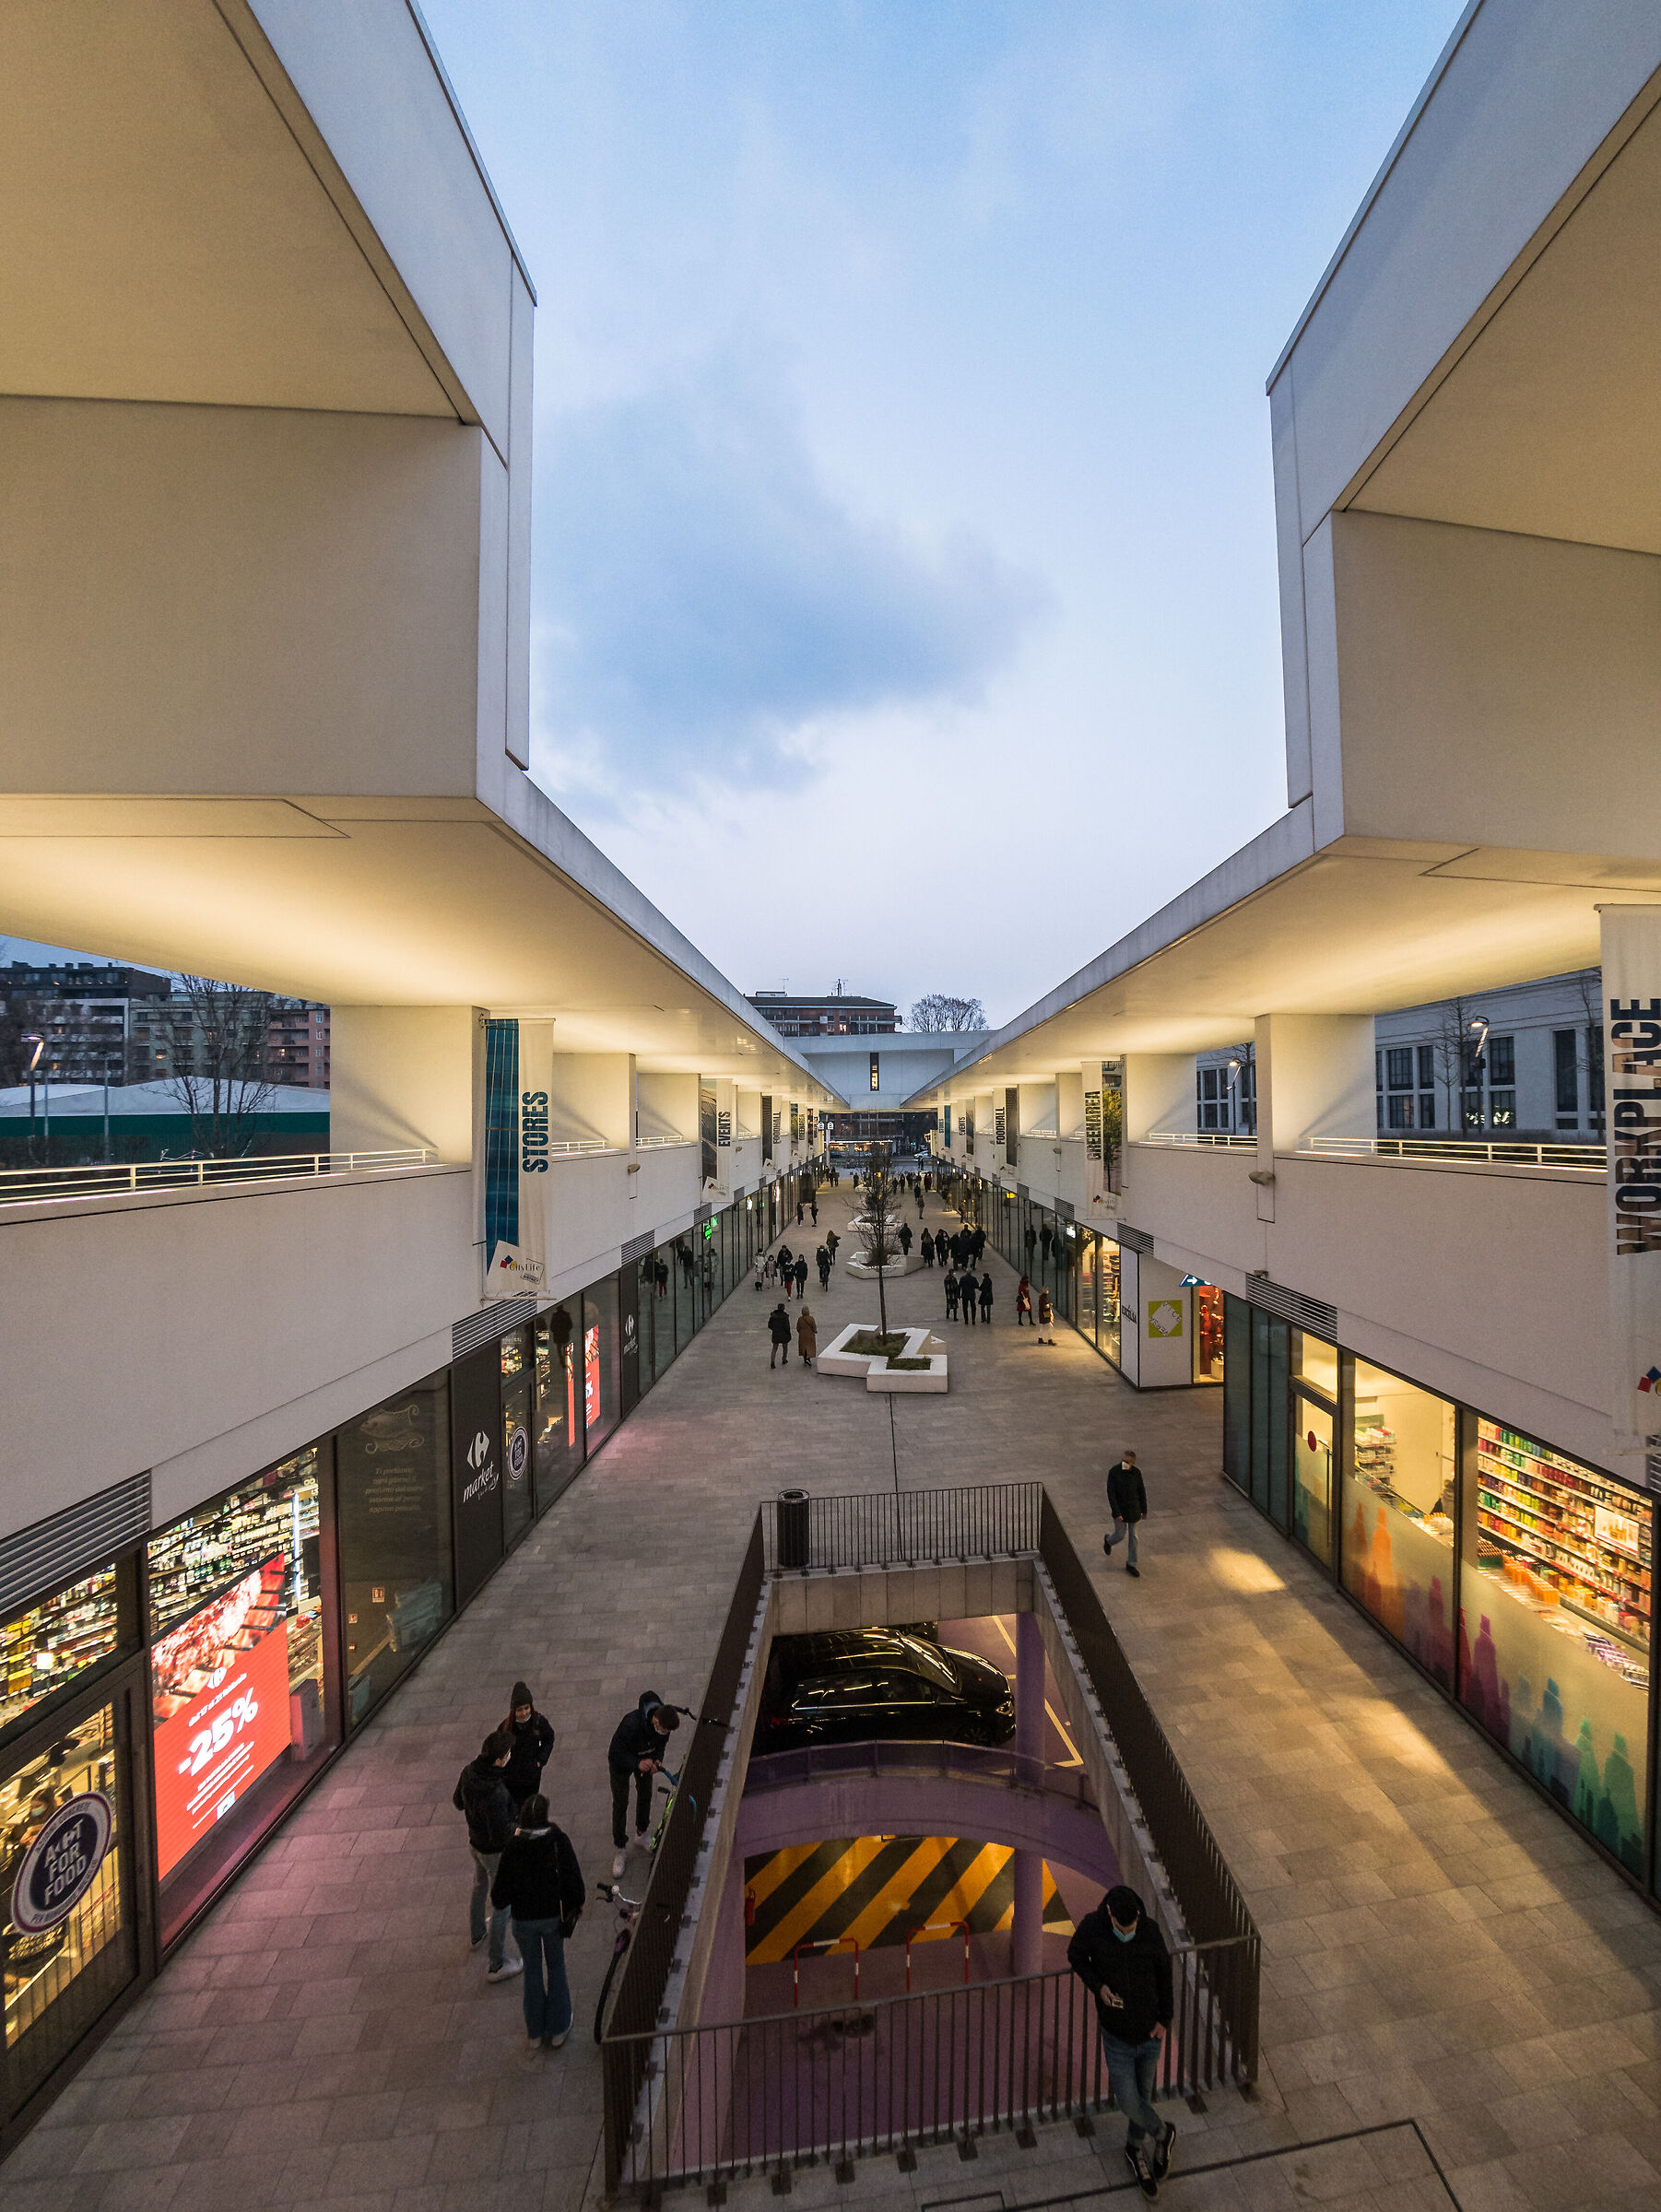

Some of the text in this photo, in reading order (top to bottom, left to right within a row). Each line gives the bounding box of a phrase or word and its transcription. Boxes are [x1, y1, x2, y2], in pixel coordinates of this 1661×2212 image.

[522, 1091, 548, 1173] STORES
[718, 1111, 731, 1147] EVENTS
[772, 1111, 782, 1145] FOODHALL
[995, 1107, 1006, 1145] FOODHALL
[1085, 1090, 1101, 1161] GREENAREA
[1609, 998, 1661, 1255] WORKPLACE
[509, 1262, 541, 1272] CityLife
[463, 1460, 495, 1503] market
[178, 1687, 259, 1777] -25%
[44, 1854, 88, 1906] FOOD
[49, 1841, 81, 1882] FOR
